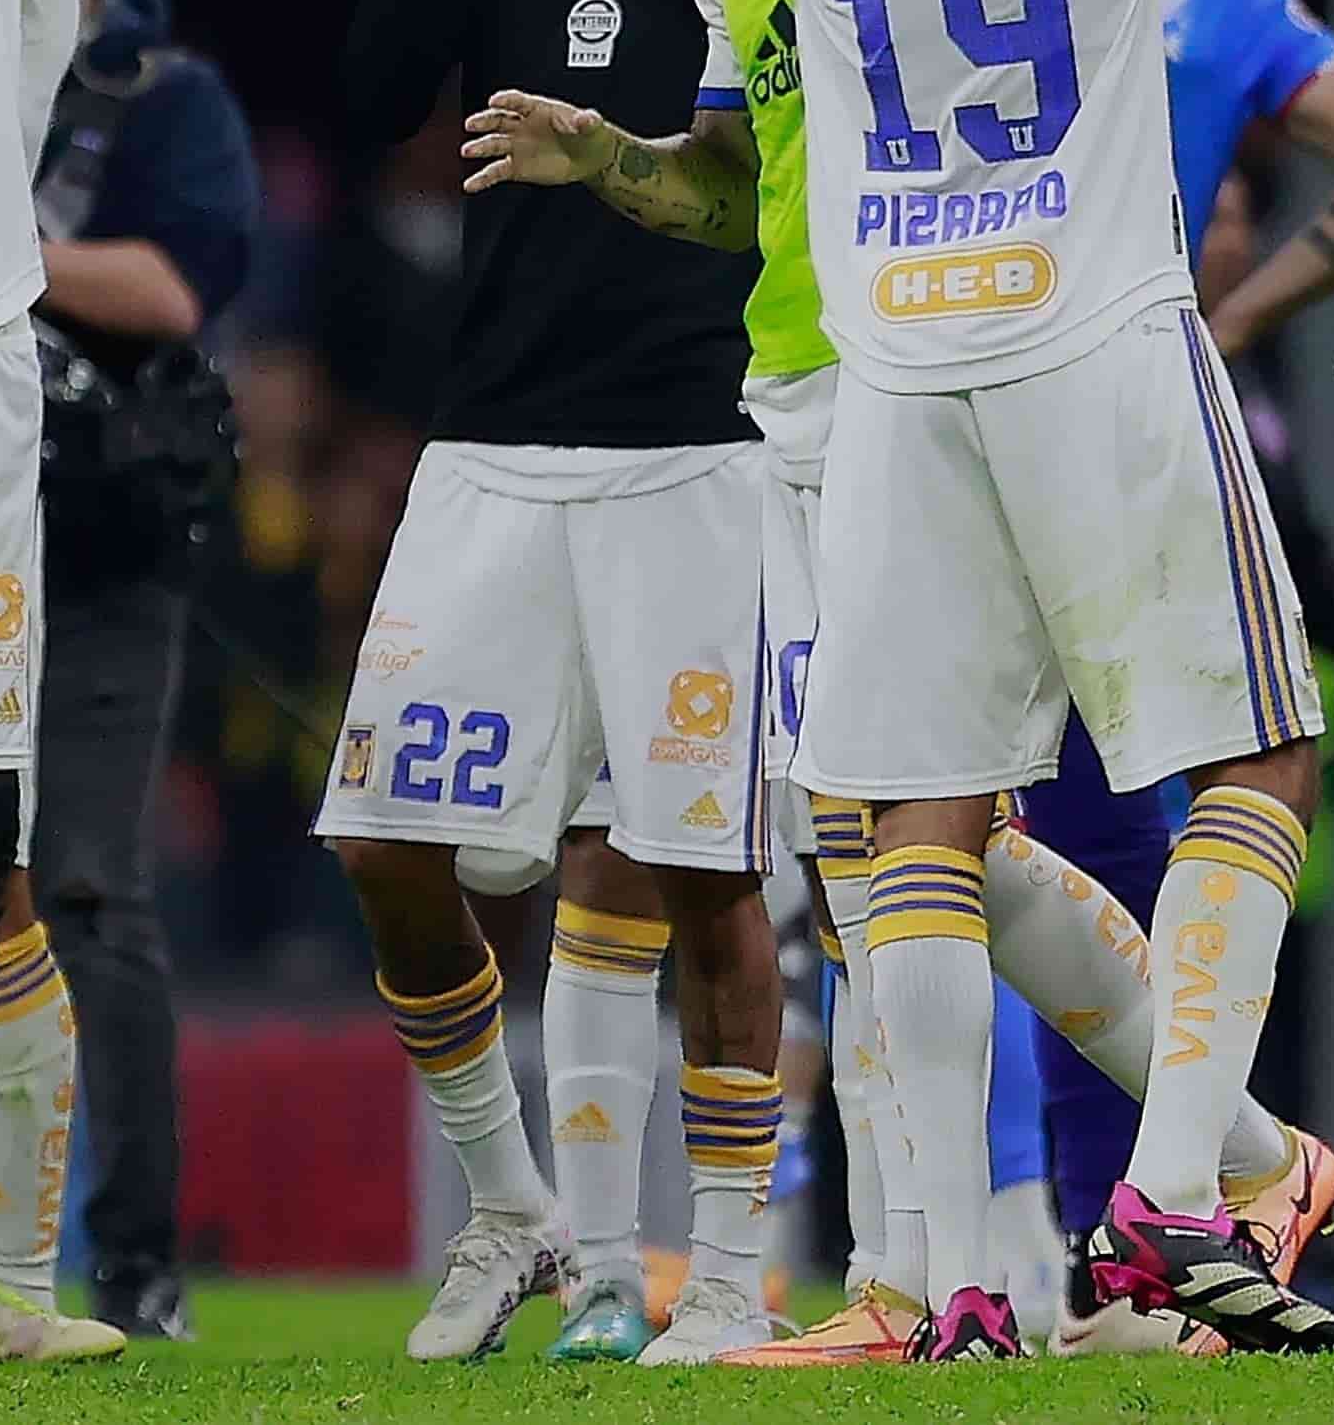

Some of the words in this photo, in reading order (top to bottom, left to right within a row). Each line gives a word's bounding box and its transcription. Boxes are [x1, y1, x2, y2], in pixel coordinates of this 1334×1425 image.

[886, 139, 911, 165] U
[1008, 125, 1035, 152] U
[855, 170, 1068, 247] PIZARRO
[391, 703, 511, 810] 22
